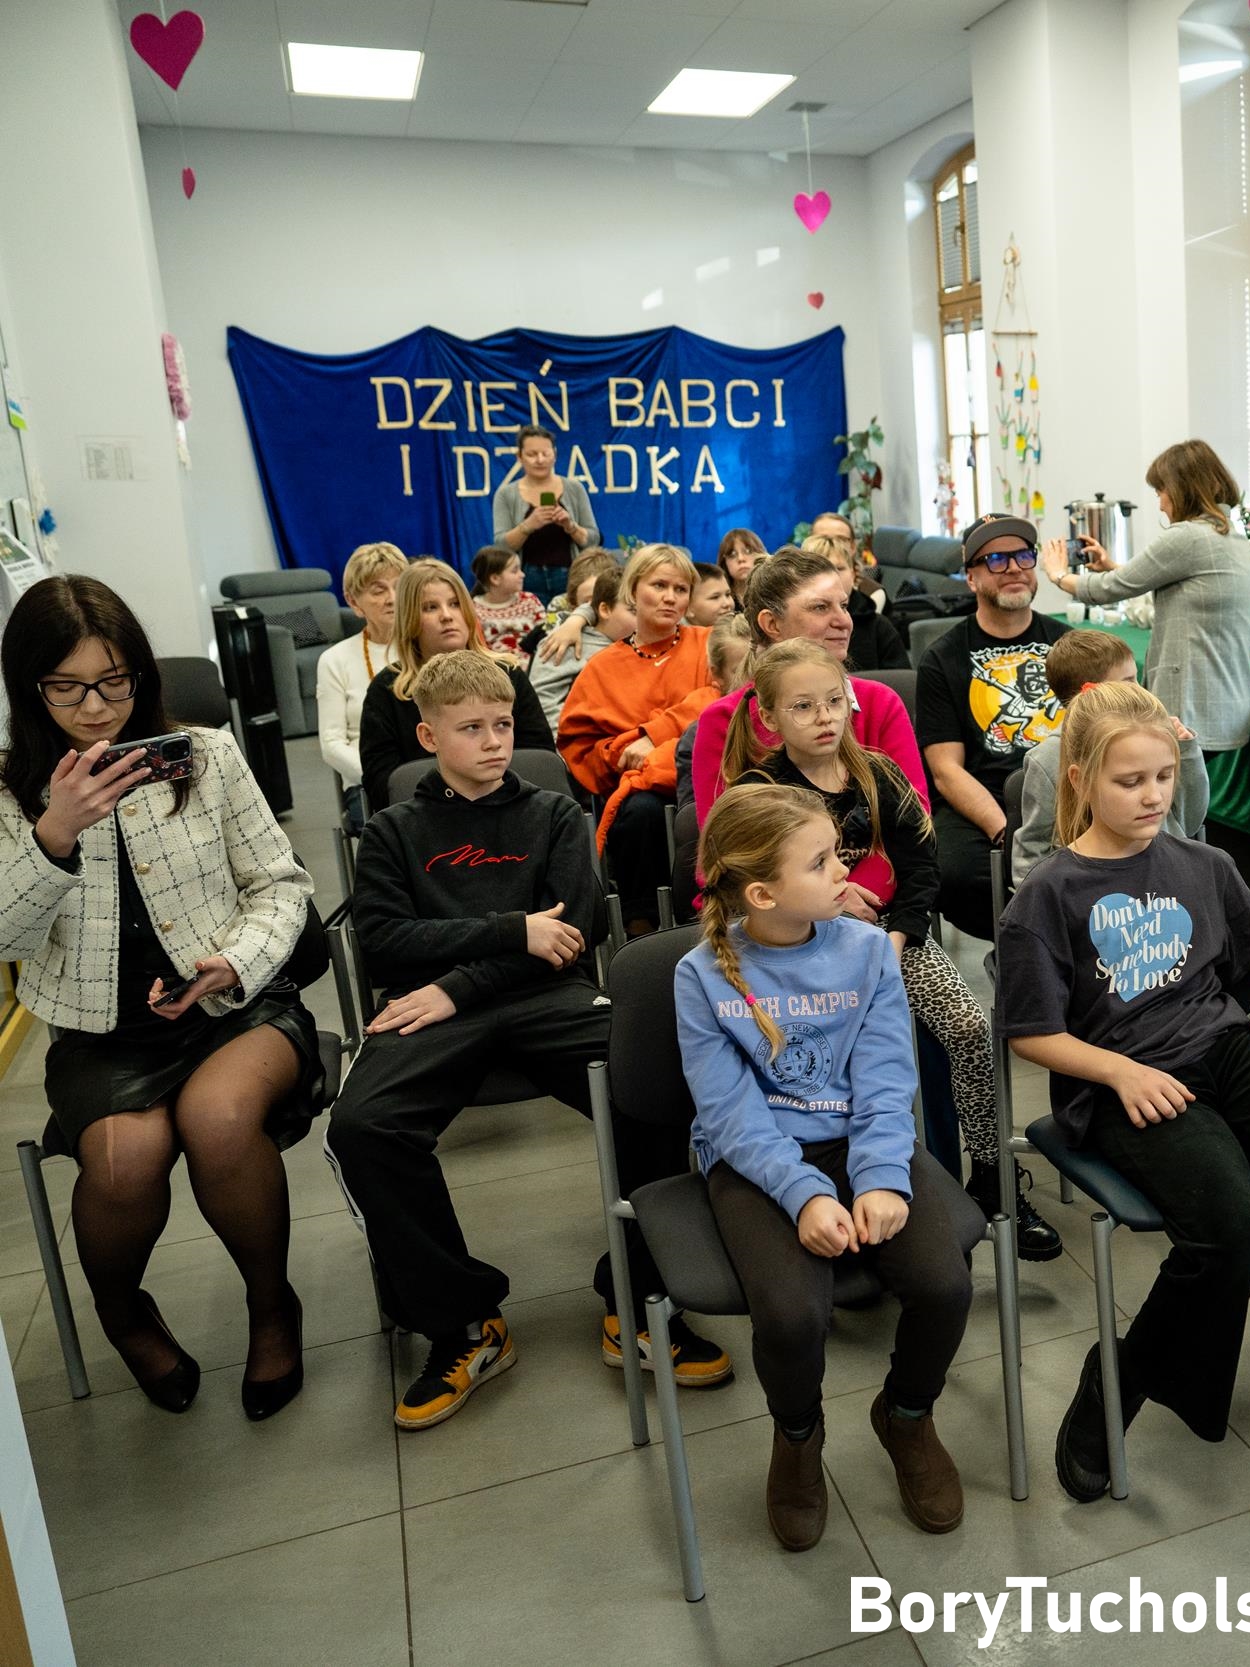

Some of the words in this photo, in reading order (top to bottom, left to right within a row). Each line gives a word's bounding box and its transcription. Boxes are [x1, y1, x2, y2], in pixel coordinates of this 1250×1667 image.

[370, 359, 570, 433] DZIEŃ
[608, 377, 786, 430] BABCI
[400, 444, 413, 496] I
[452, 444, 725, 497] DZADKA
[1092, 897, 1145, 931] Don't
[1145, 892, 1179, 912] You
[1119, 912, 1164, 952] Need
[1095, 933, 1193, 980] Somebody
[1107, 972, 1128, 994] To
[1133, 967, 1182, 992] Love
[788, 990, 859, 1016] CAMPUS
[792, 1024, 810, 1034] NEW
[768, 1094, 806, 1110] UNITED
[809, 1100, 848, 1112] STATES
